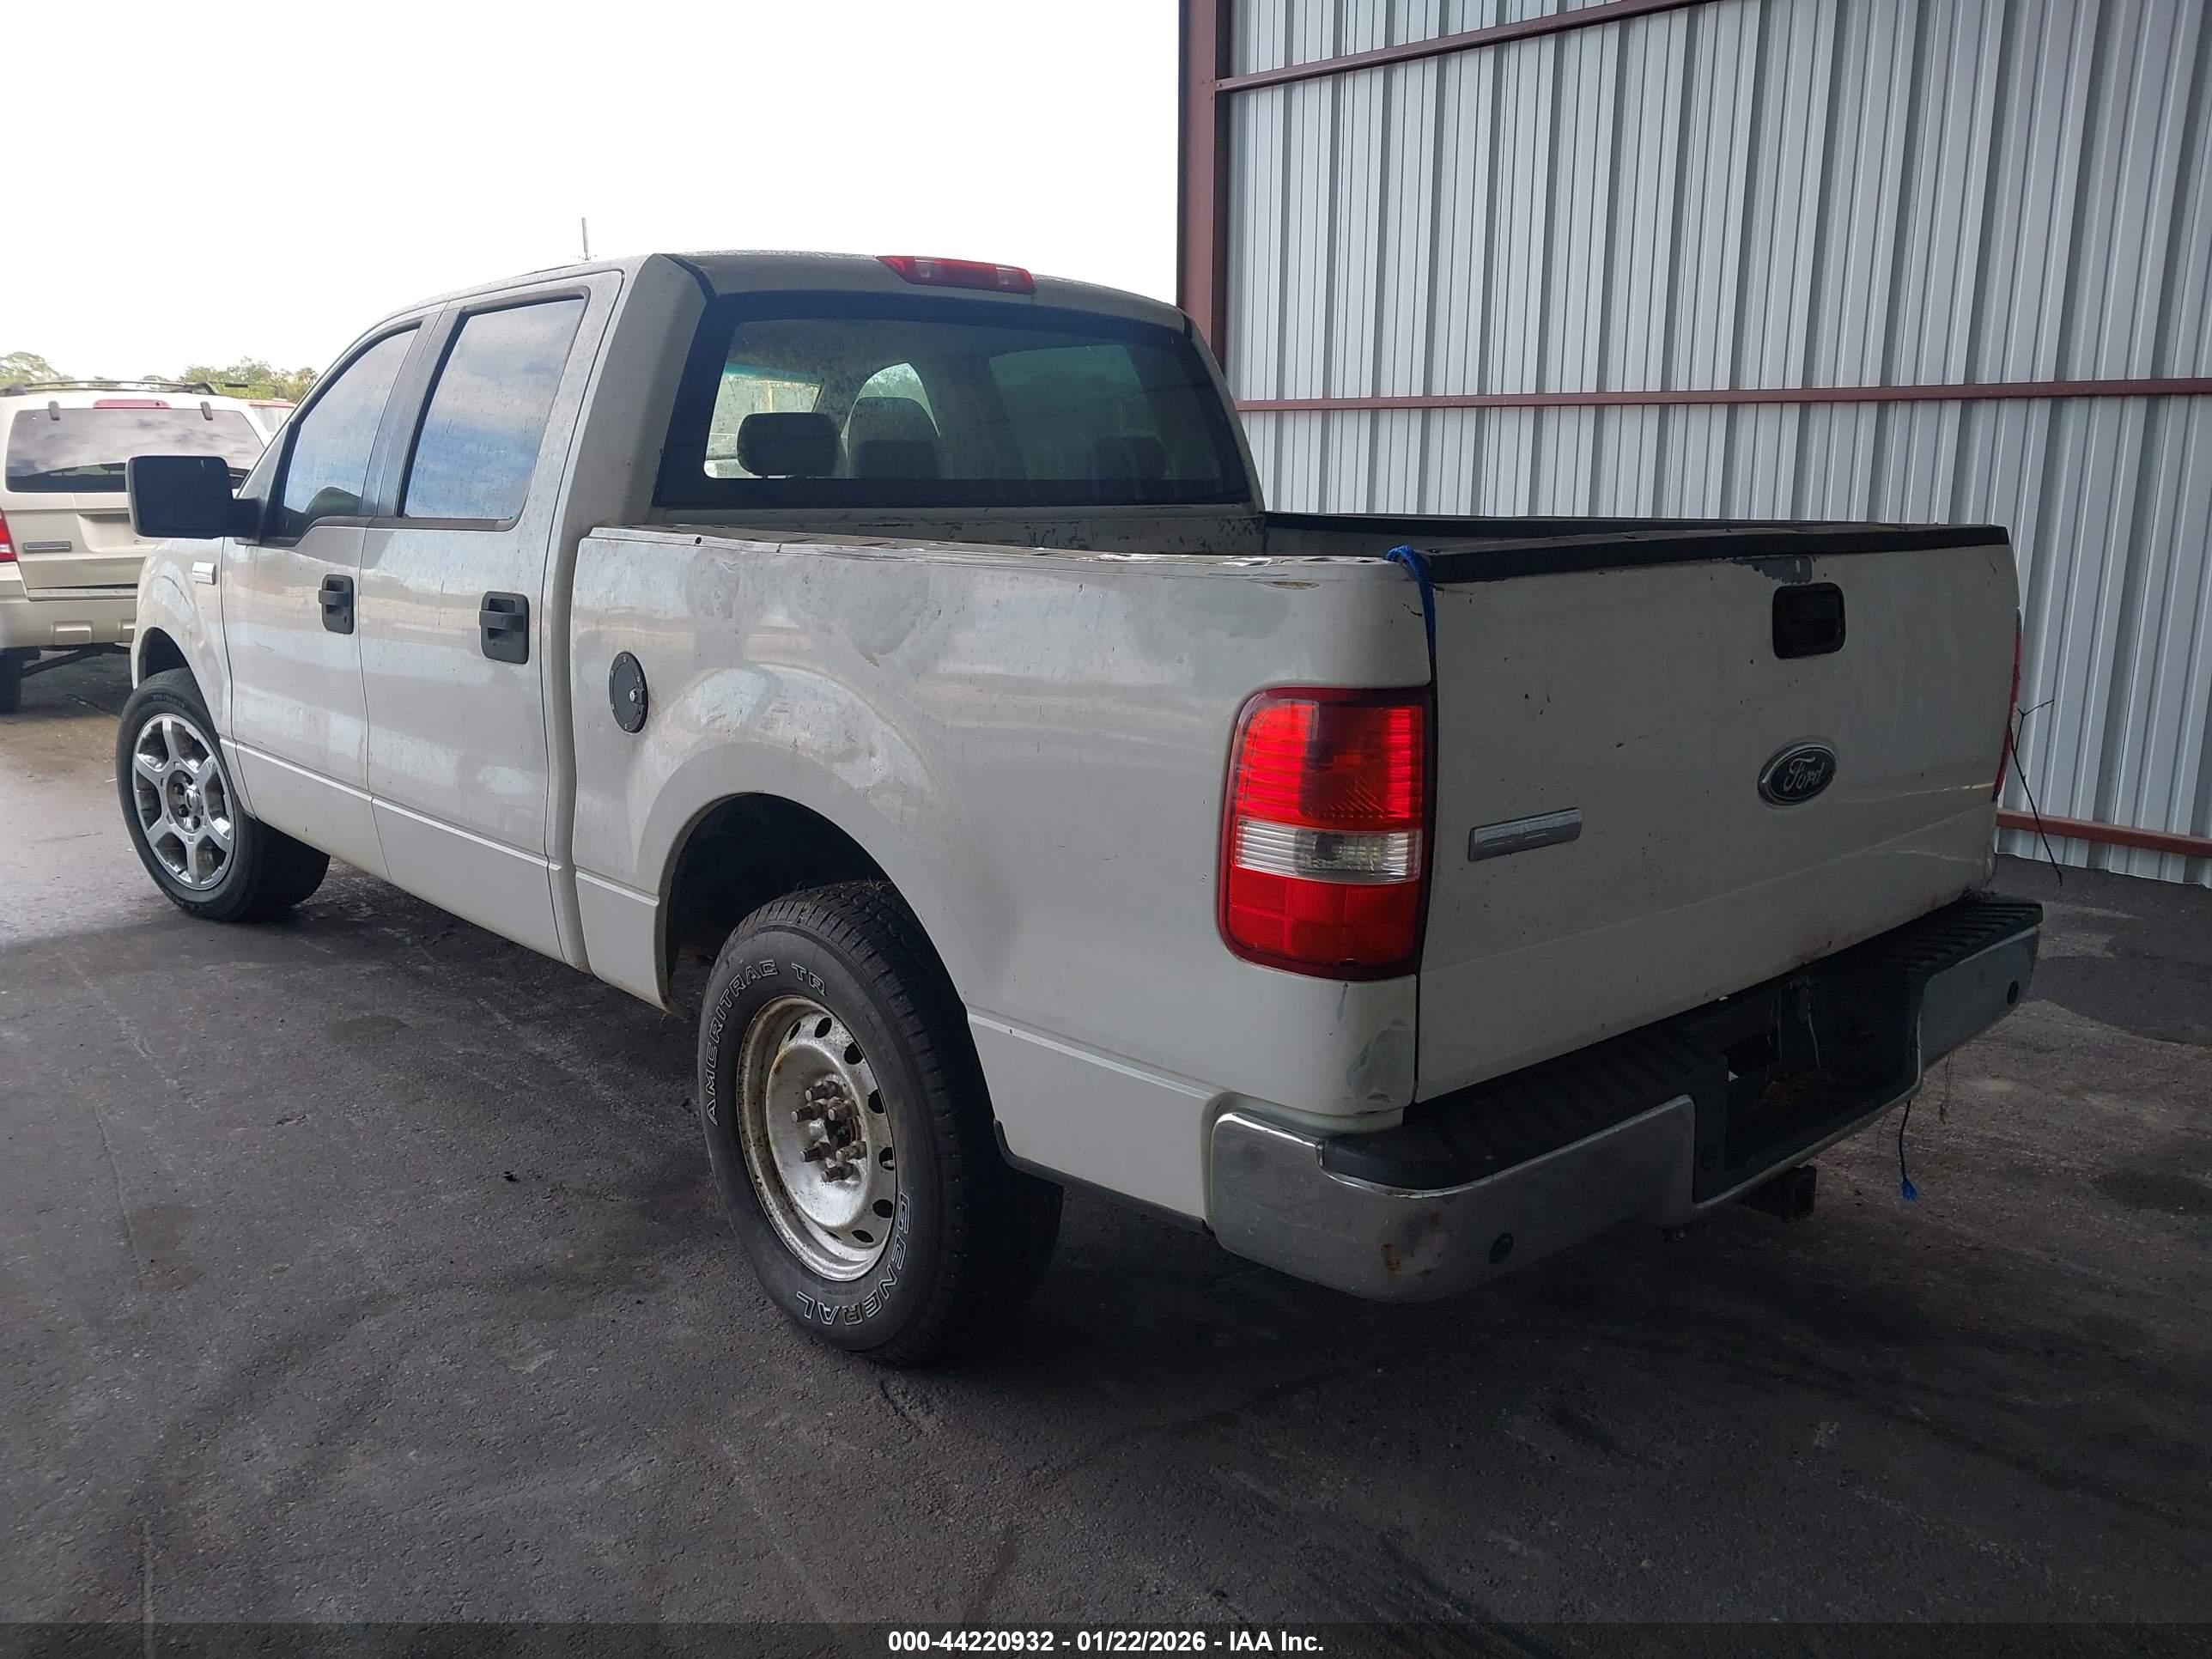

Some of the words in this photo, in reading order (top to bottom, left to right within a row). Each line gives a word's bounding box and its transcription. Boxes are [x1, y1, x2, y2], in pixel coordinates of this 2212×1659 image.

[1784, 757, 1825, 791] Ford
[705, 959, 779, 1127] AMERITRAC
[791, 963, 826, 997] TR
[796, 1190, 911, 1326] GENERAL
